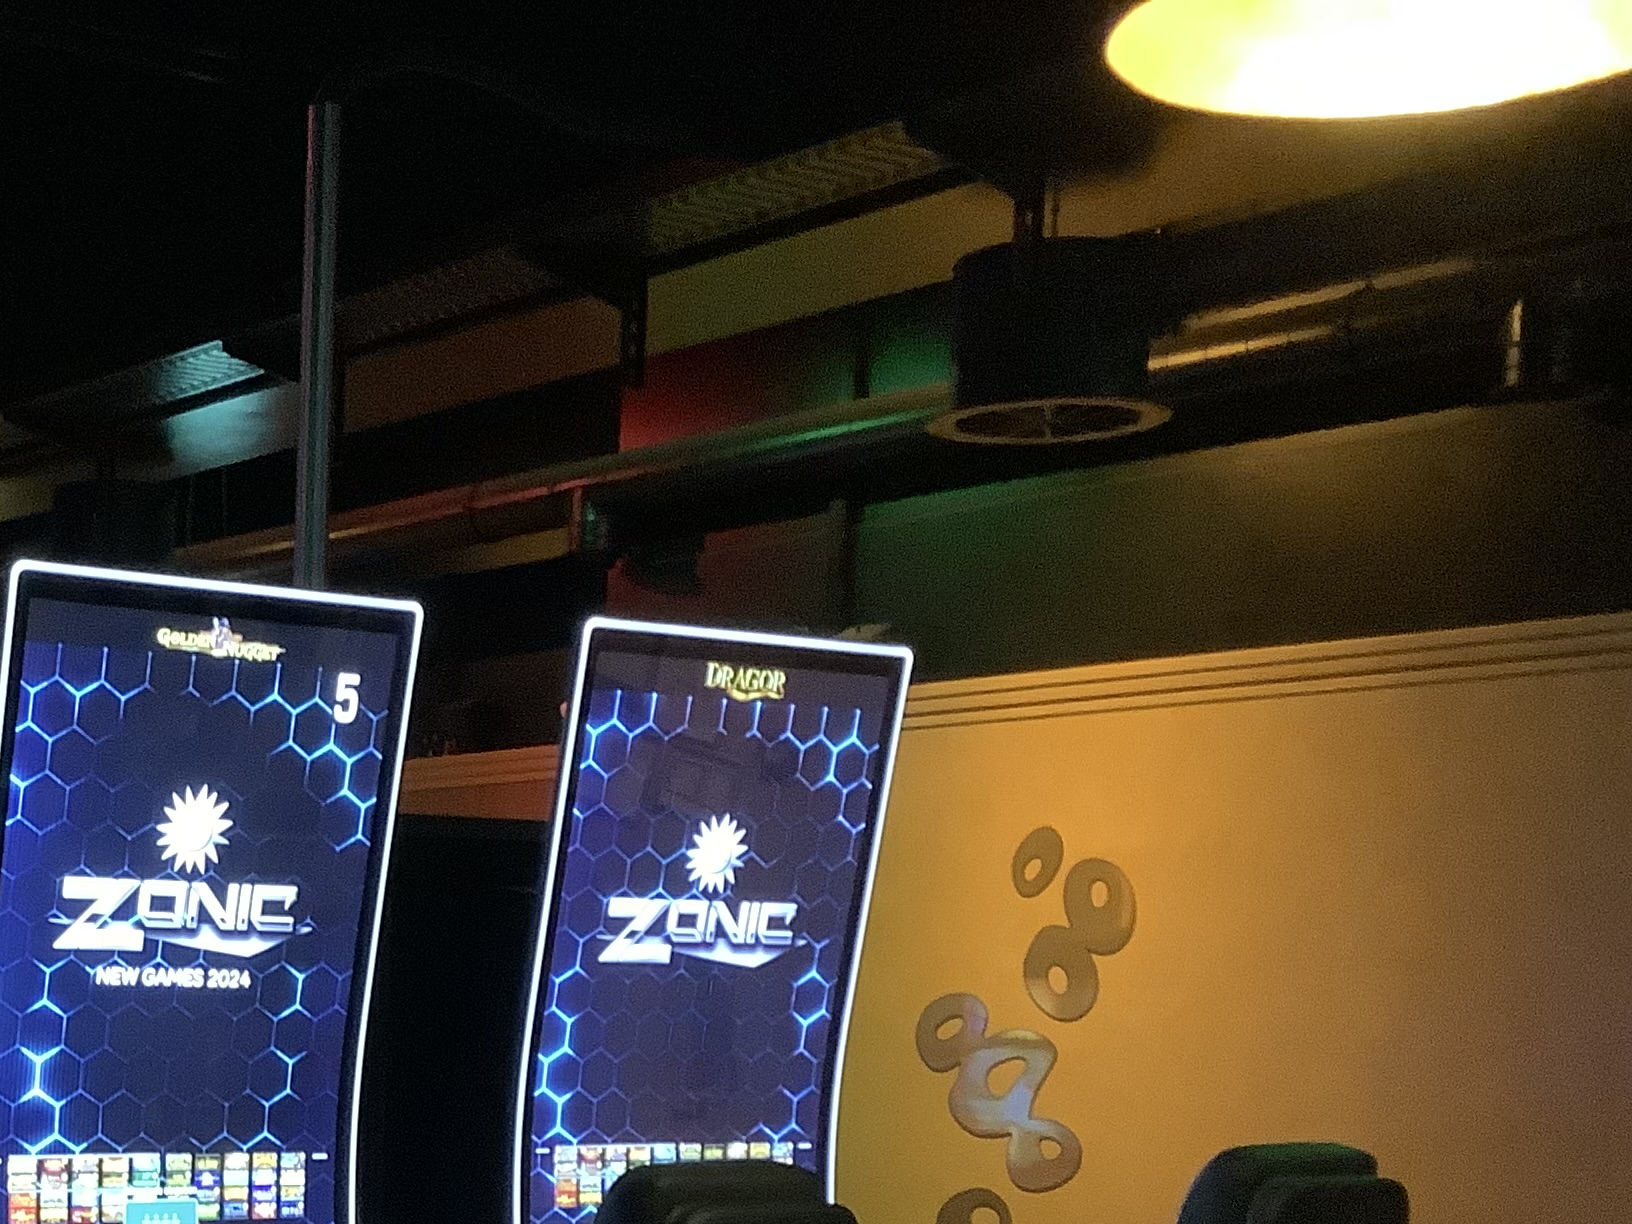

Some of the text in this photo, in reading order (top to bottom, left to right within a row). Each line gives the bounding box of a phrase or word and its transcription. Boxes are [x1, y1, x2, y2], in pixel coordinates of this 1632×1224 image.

[332, 672, 362, 724] 5
[704, 661, 787, 692] DRAGOR
[53, 876, 299, 953] ZONIC
[598, 897, 798, 965] ZONIC
[95, 965, 252, 989] NEW GAMES 2024
